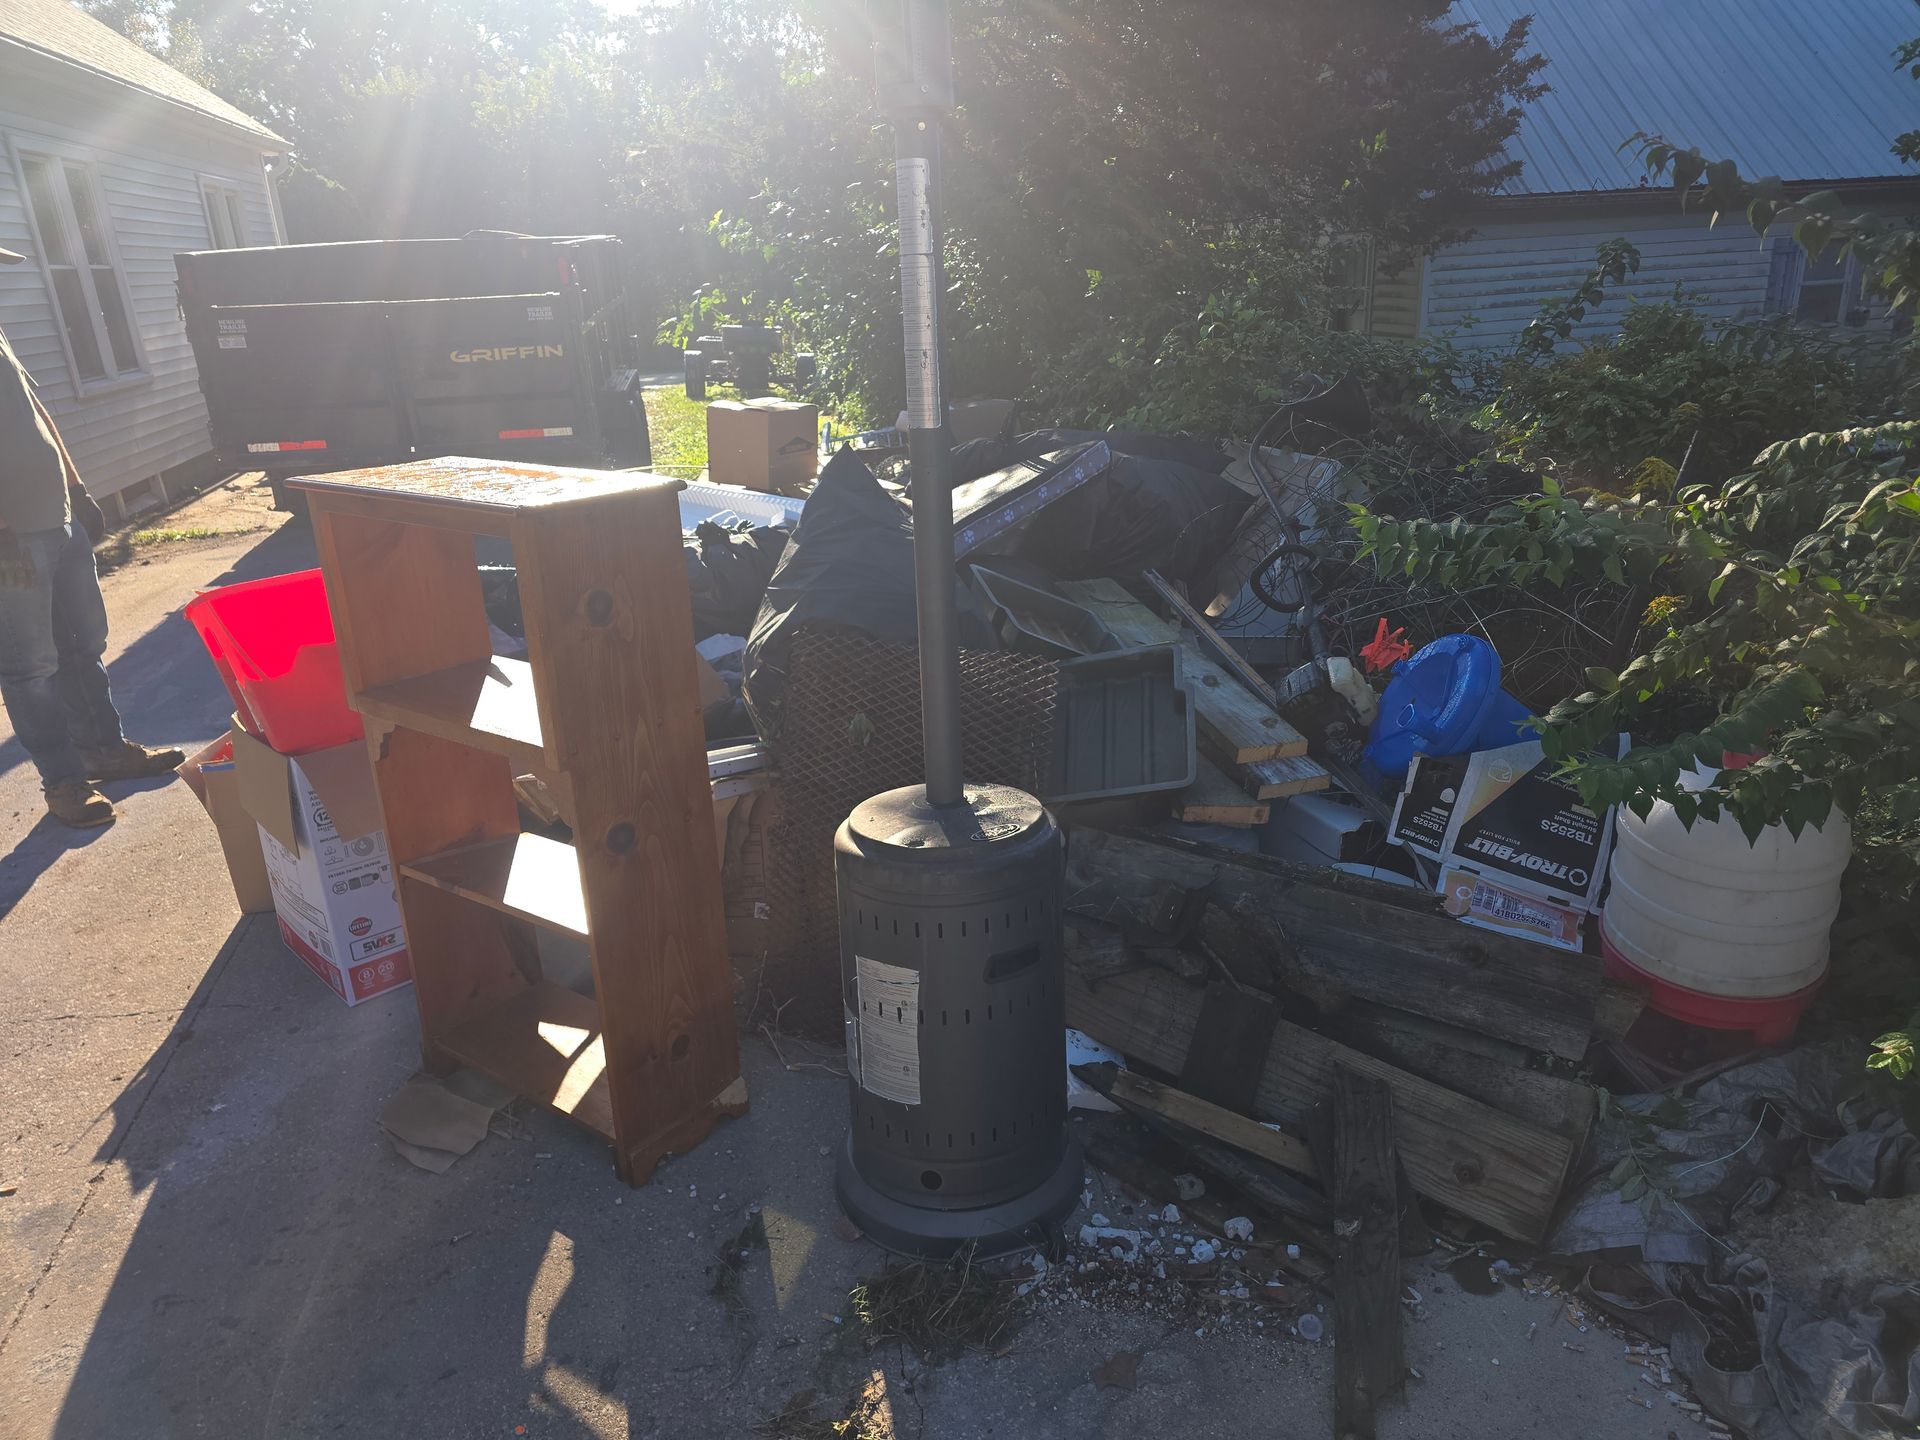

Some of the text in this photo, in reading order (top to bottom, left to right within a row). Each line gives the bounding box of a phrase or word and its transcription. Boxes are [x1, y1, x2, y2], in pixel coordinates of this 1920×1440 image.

[450, 344, 563, 363] GRIFFIN
[1412, 815, 1443, 833] TB252S
[1553, 814, 1597, 833] Straight Shaft
[1559, 809, 1585, 823] Trimmer
[1585, 818, 1598, 827] Gas
[1400, 827, 1434, 844] TROY-BILT
[1505, 837, 1521, 845] BUILT
[1540, 819, 1594, 846] TB252S
